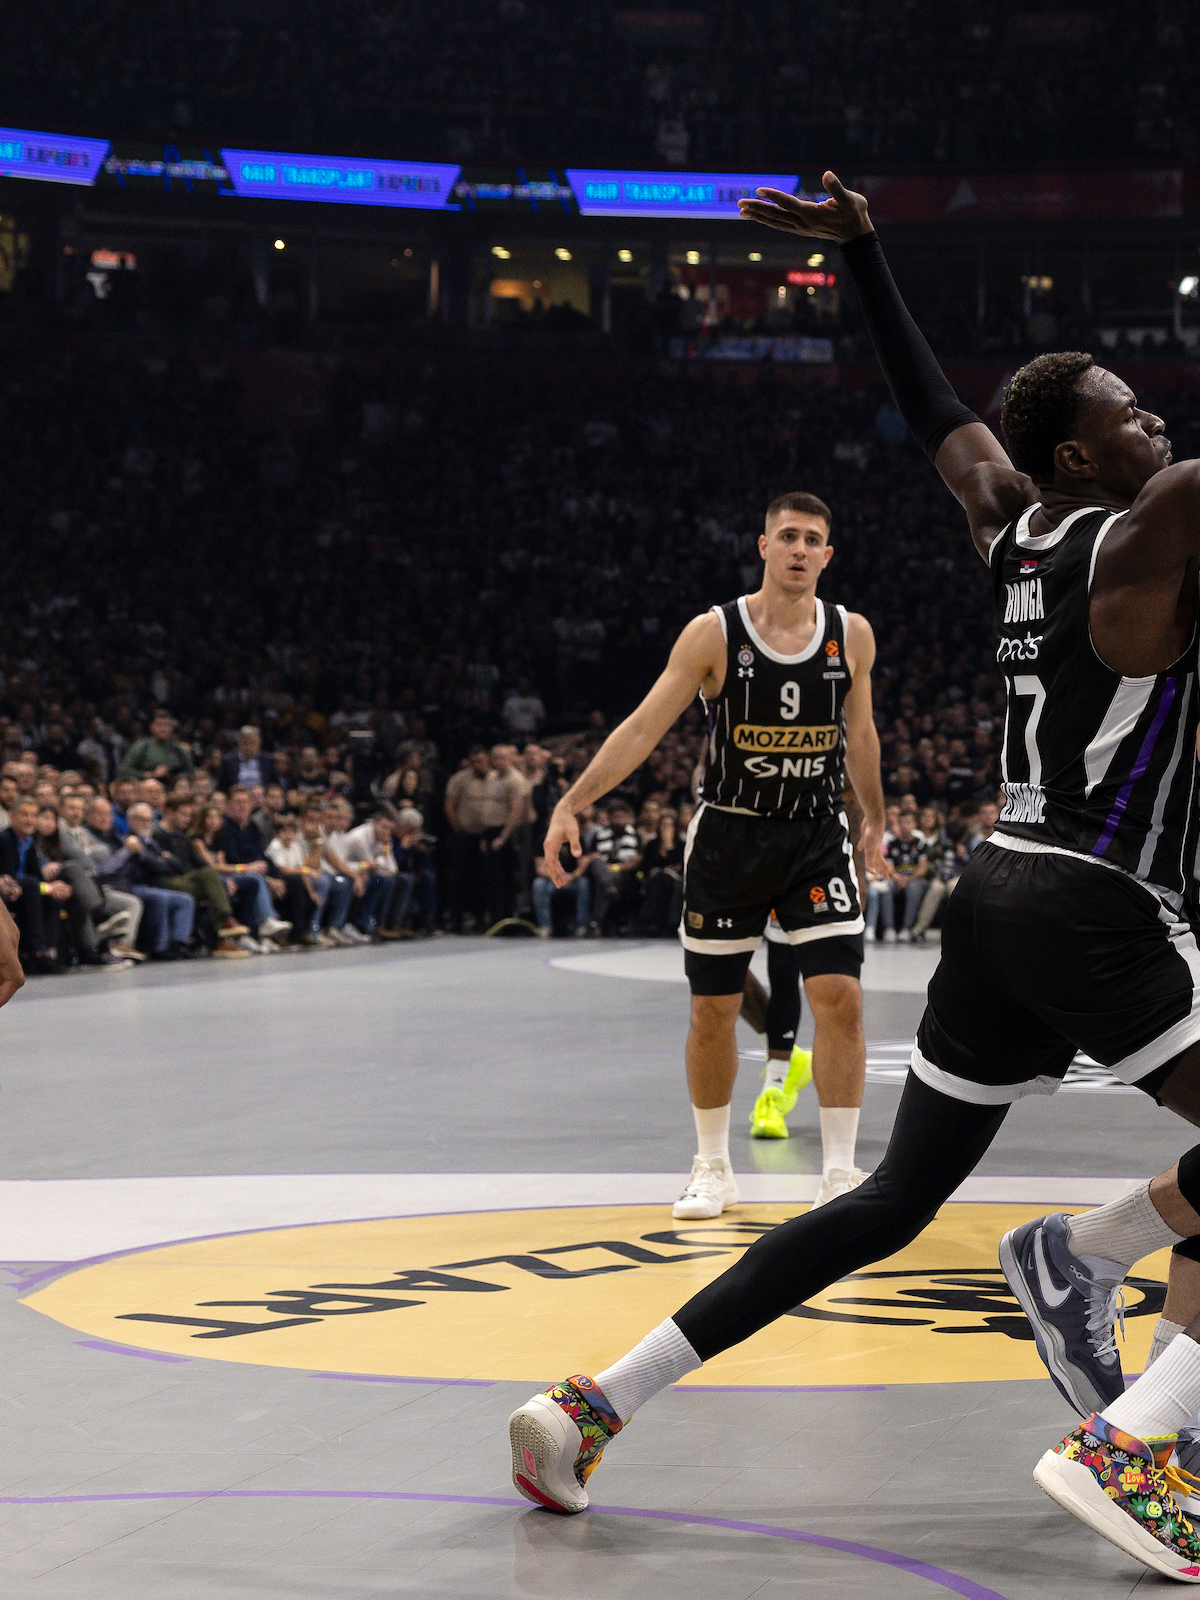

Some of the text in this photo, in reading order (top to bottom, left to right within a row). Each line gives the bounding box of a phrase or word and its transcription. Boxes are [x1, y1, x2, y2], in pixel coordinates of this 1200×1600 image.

[1004, 577, 1045, 624] BONGA
[996, 631, 1044, 662] mts
[780, 680, 800, 720] 9
[737, 729, 836, 748] MOZZART
[781, 756, 826, 778] NIS
[827, 876, 852, 913] 9
[114, 1217, 797, 1338] OZZART
[1125, 1471, 1146, 1485] Love
